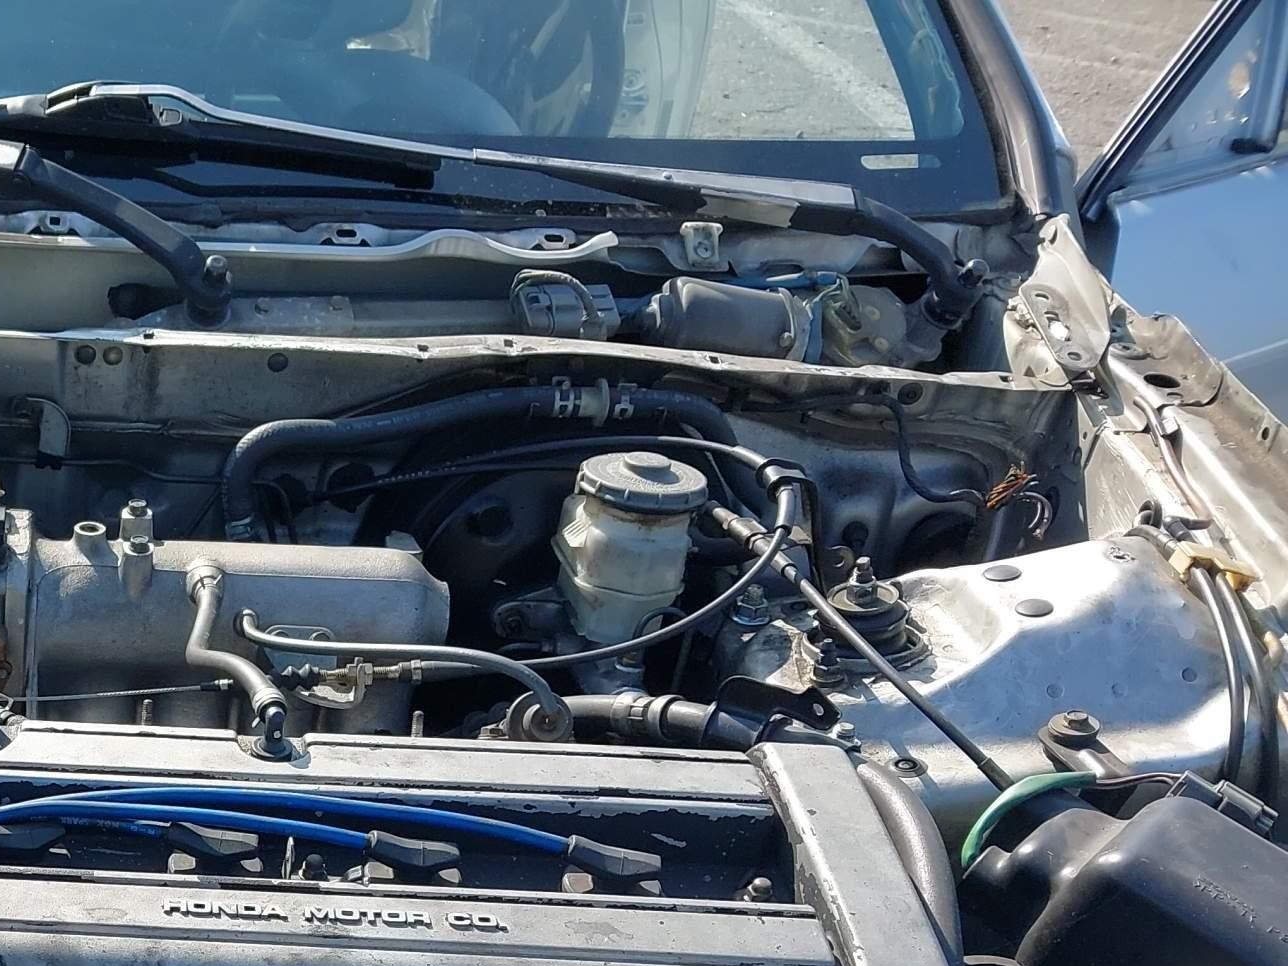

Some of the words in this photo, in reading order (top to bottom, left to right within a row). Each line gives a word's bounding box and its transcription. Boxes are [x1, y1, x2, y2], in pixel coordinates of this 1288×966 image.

[162, 899, 289, 921] HONDA
[304, 906, 432, 929] MOTOR
[447, 912, 509, 933] CO.
